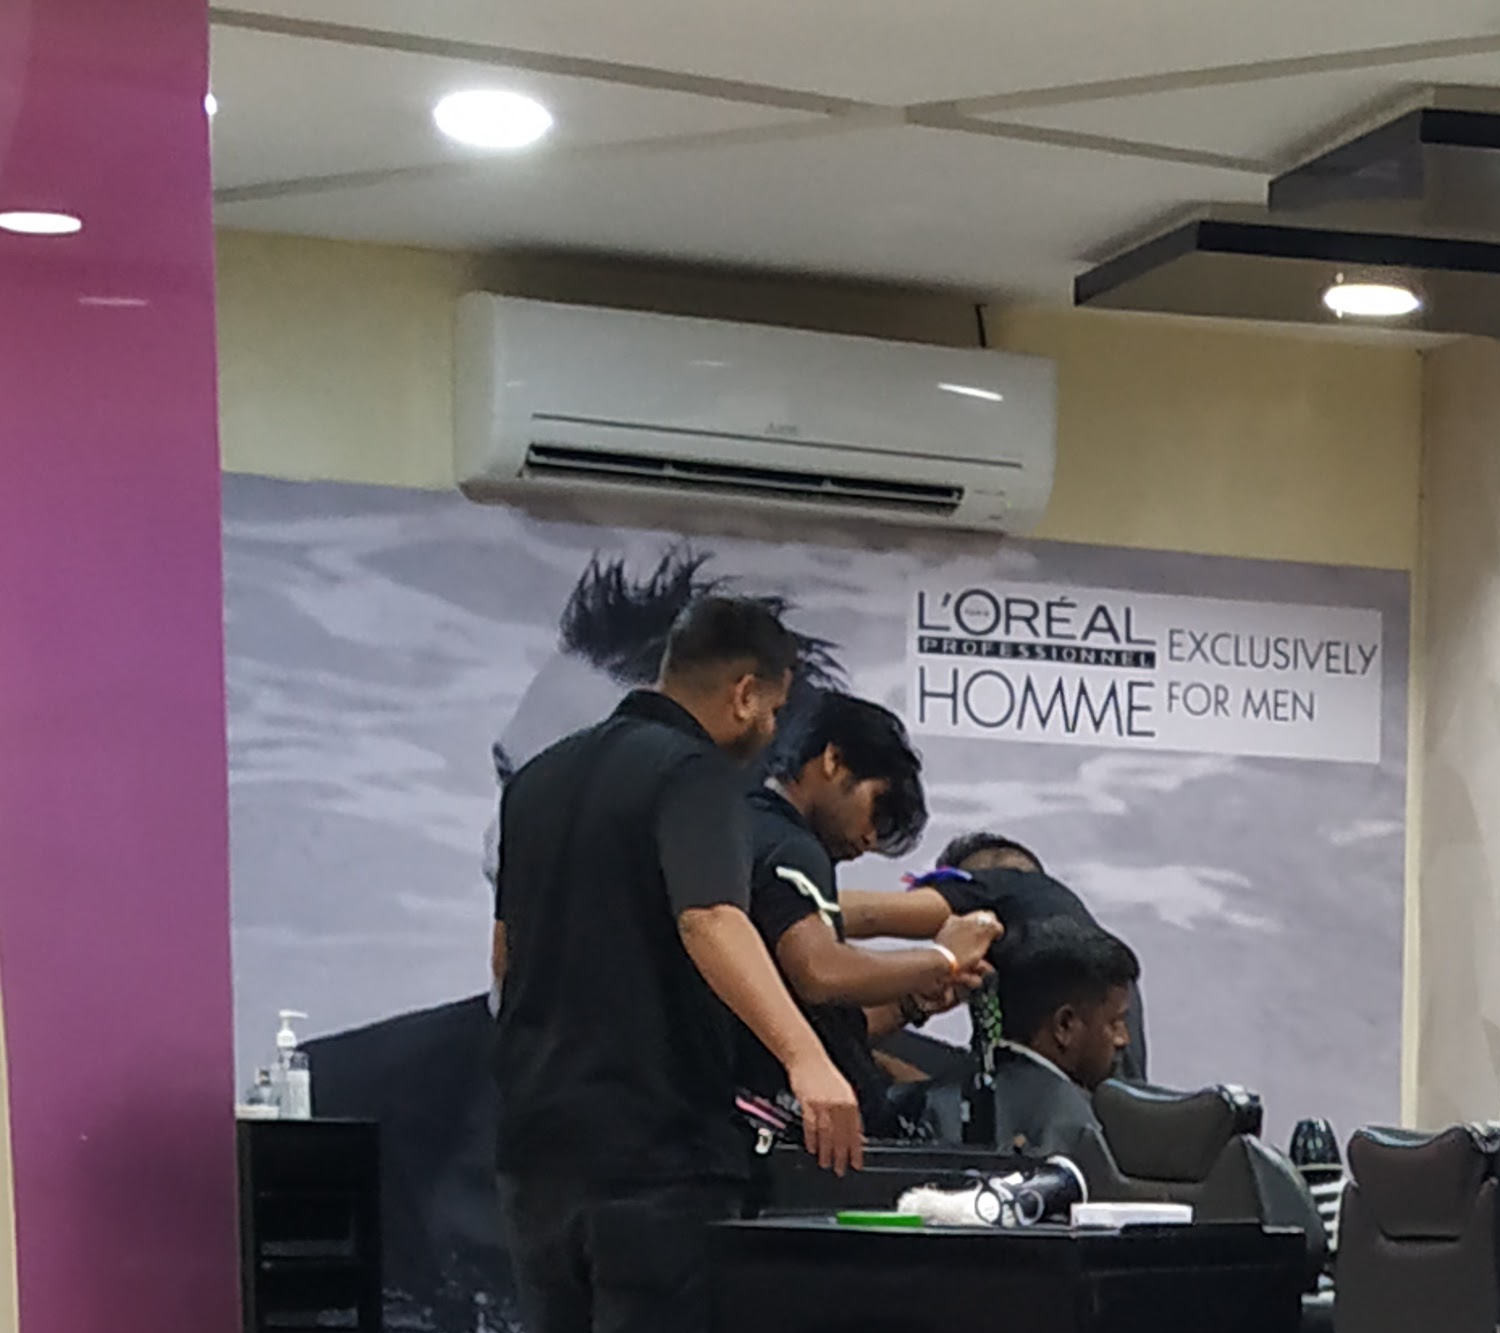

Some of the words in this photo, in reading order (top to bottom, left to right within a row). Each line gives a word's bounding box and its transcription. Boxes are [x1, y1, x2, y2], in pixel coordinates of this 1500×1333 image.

[918, 589, 1156, 646] L'ORÉAL
[922, 638, 1153, 667] PROFESSIONNEL
[1169, 629, 1378, 675] EXCLUSIVELY
[919, 666, 1156, 738] HOMME
[1168, 681, 1230, 718] FOR
[1243, 688, 1315, 722] MEN
